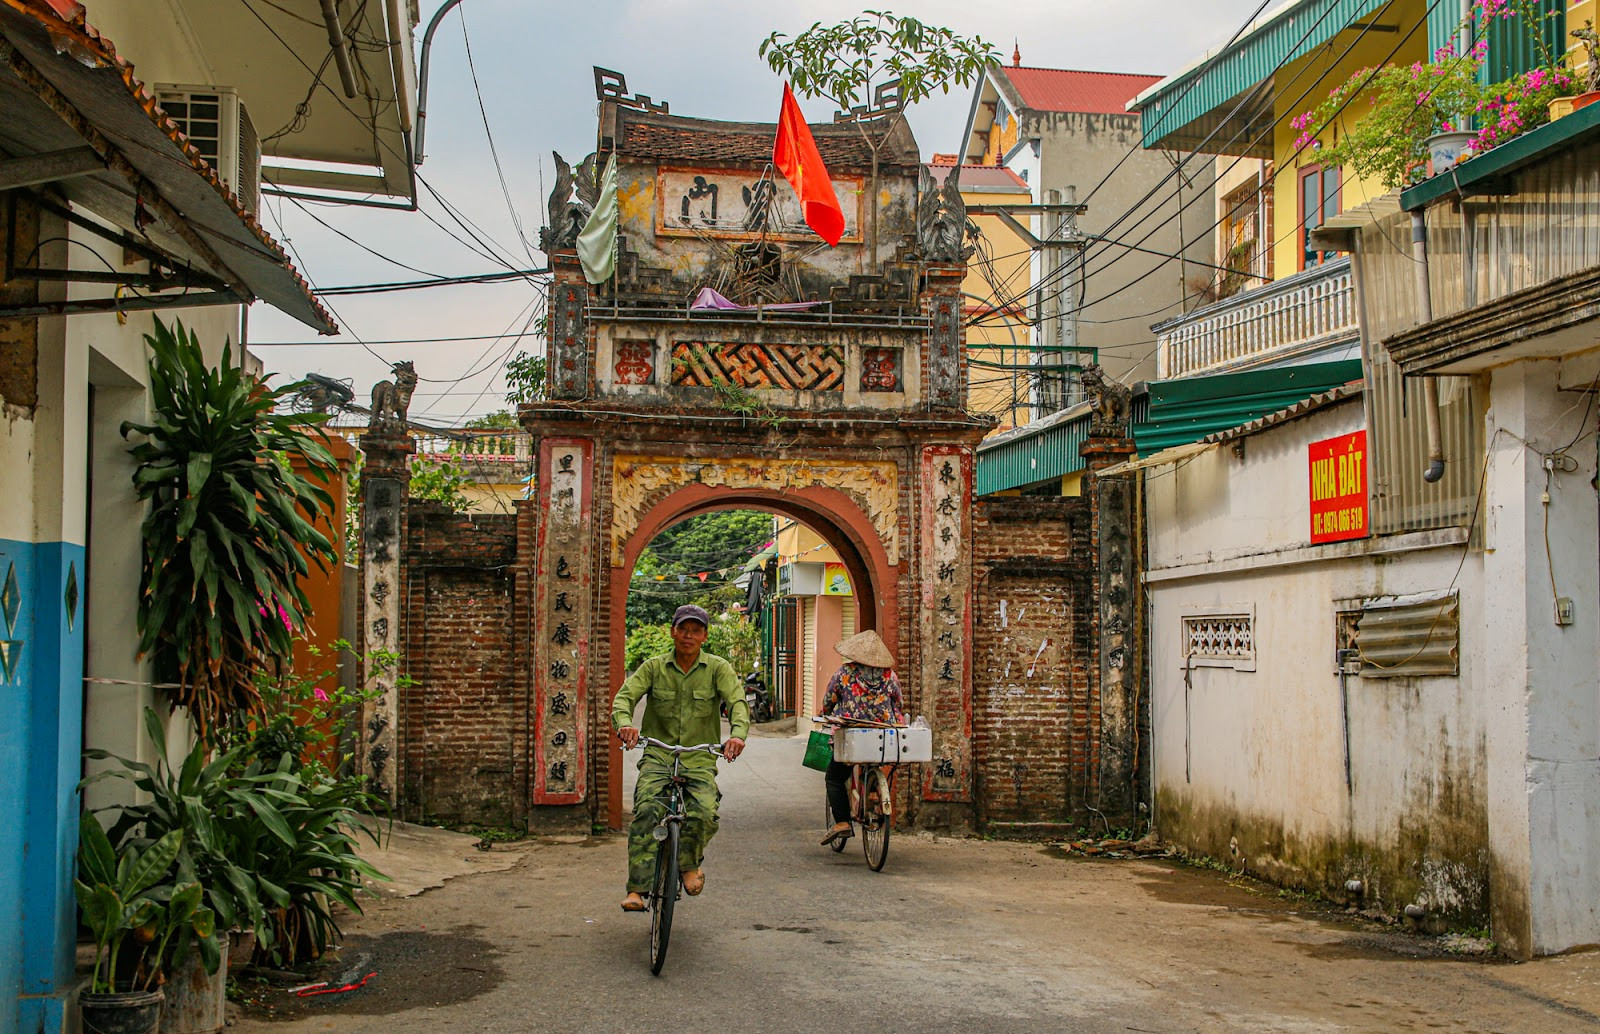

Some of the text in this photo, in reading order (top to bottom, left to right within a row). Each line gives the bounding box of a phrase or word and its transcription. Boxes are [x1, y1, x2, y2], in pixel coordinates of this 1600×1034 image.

[1312, 436, 1362, 501] NHÀ ĐẤT
[1324, 511, 1338, 534] 0974
[1351, 506, 1363, 530] 519
